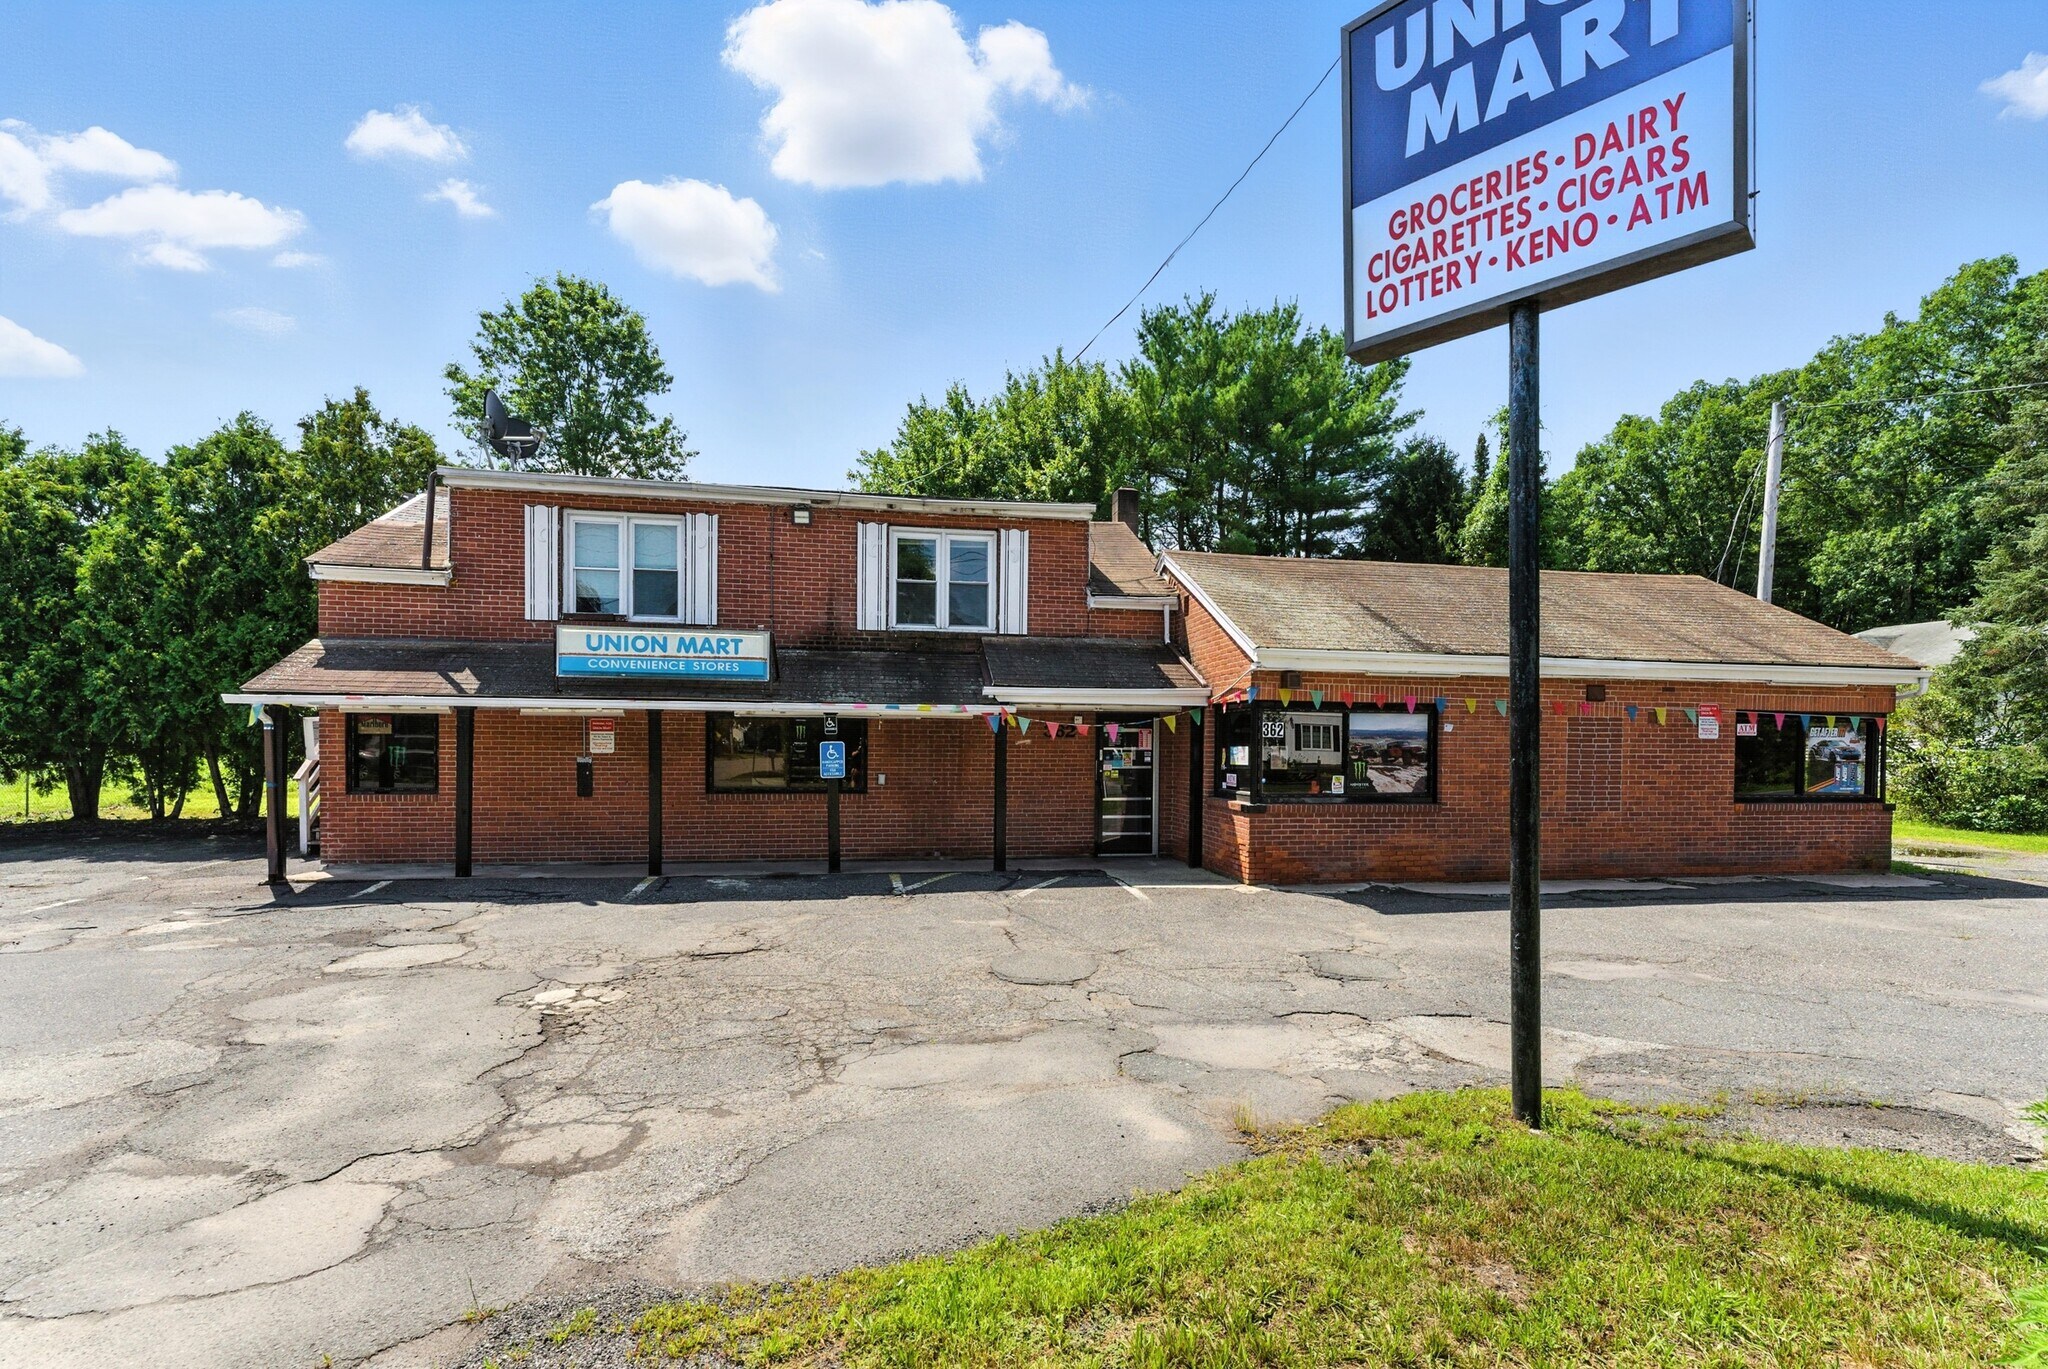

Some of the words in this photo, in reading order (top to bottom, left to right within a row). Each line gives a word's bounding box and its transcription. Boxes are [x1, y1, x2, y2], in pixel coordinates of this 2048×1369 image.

[1367, 196, 1531, 284] CIGARETTES
[1557, 135, 1690, 213] CIGARS
[1387, 150, 1549, 241] GROCERIES
[1574, 92, 1687, 170] DAIRY
[1366, 250, 1482, 320] LOTTERY
[1506, 212, 1599, 273] KENO
[1627, 171, 1710, 232] ATM
[586, 633, 668, 654] UNION
[676, 636, 743, 656] MART
[587, 658, 686, 671] CONVENIENCE
[693, 661, 740, 673] STORES
[1263, 723, 1283, 737] 362
